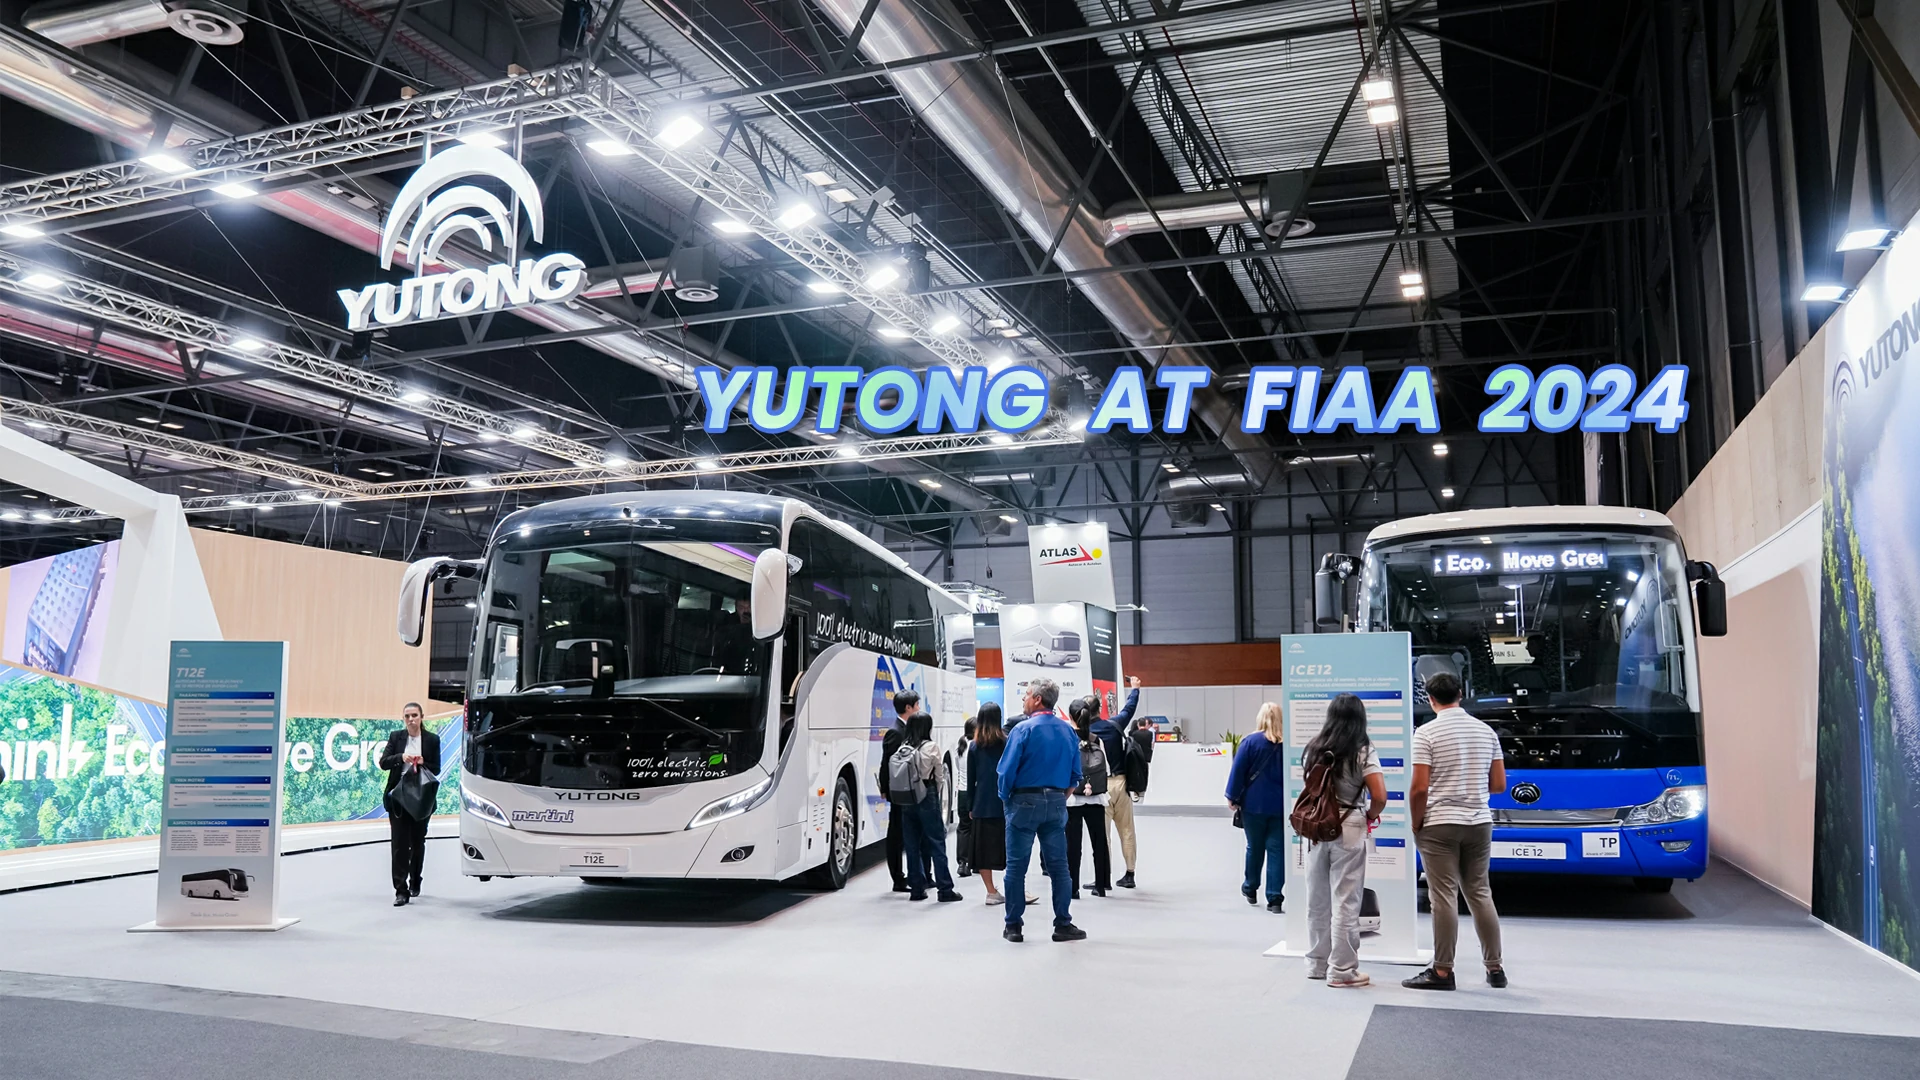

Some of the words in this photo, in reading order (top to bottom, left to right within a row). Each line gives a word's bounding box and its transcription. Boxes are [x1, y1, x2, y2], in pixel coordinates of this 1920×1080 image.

[337, 252, 588, 330] YUTONG
[1858, 299, 1920, 388] YUTON
[1039, 547, 1078, 558] ATLAS
[1446, 554, 1492, 570] Eco,
[1503, 551, 1555, 569] Move
[816, 611, 836, 641] 100%
[836, 617, 867, 647] electric
[868, 631, 883, 648] zero
[884, 635, 912, 658] emissions
[176, 667, 207, 678] T12E
[1289, 664, 1333, 676] ICE12
[627, 756, 655, 769] 100%
[657, 756, 707, 768] electric
[632, 770, 659, 778] zero
[663, 767, 727, 778] emissions
[554, 792, 641, 801] YUTONG
[511, 808, 575, 824] martini
[1599, 837, 1617, 848] TP
[1512, 848, 1529, 857] ICE
[1532, 848, 1543, 857] 12
[584, 855, 605, 864] T12E
